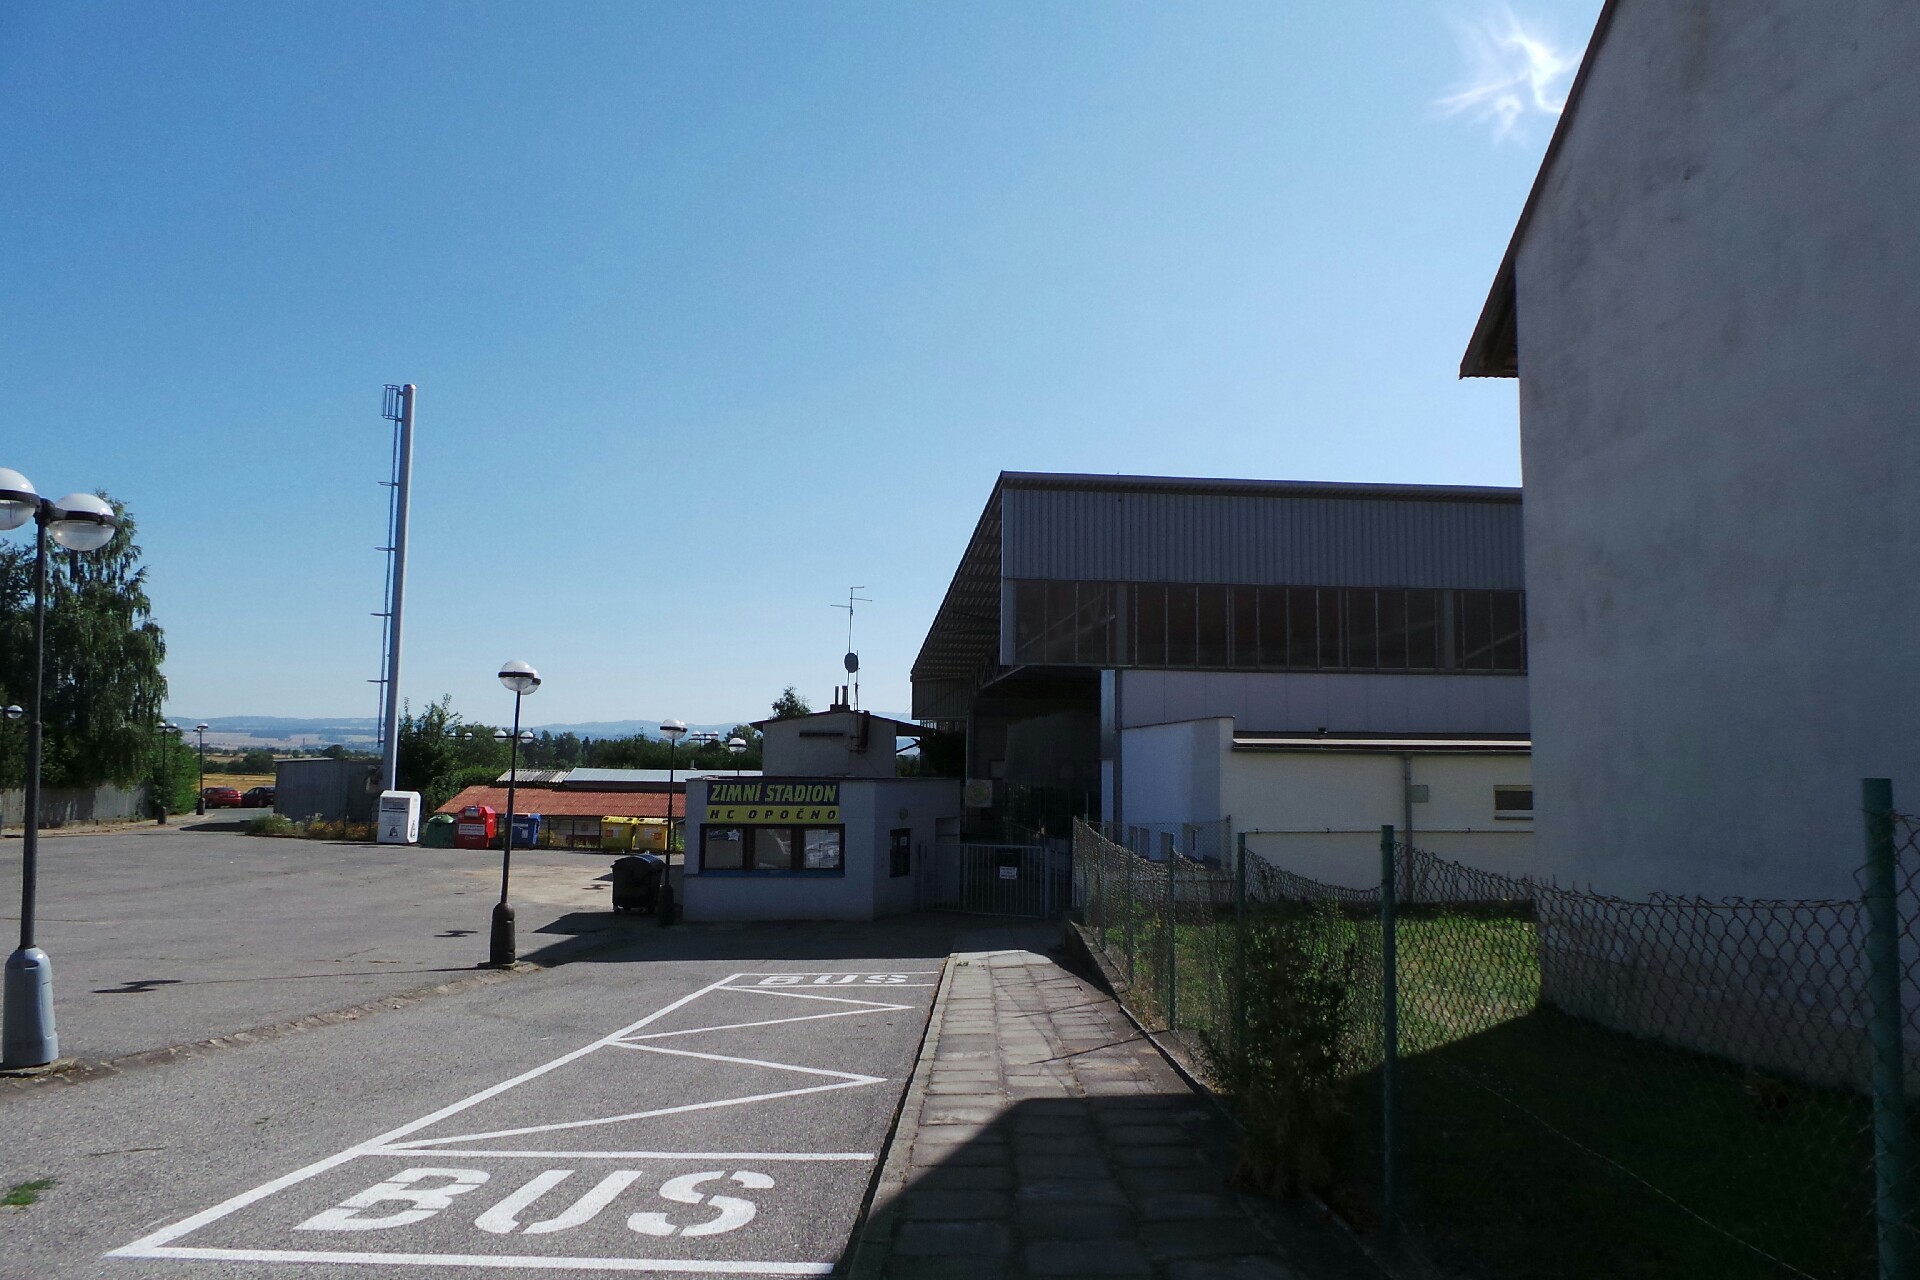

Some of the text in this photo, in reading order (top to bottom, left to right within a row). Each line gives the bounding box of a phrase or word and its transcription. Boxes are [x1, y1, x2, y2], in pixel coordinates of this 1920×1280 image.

[711, 782, 836, 802] ZIMNÍ STADION
[710, 808, 837, 819] HC OPOČNO
[757, 974, 909, 985] BUS
[293, 1168, 776, 1237] BUS
